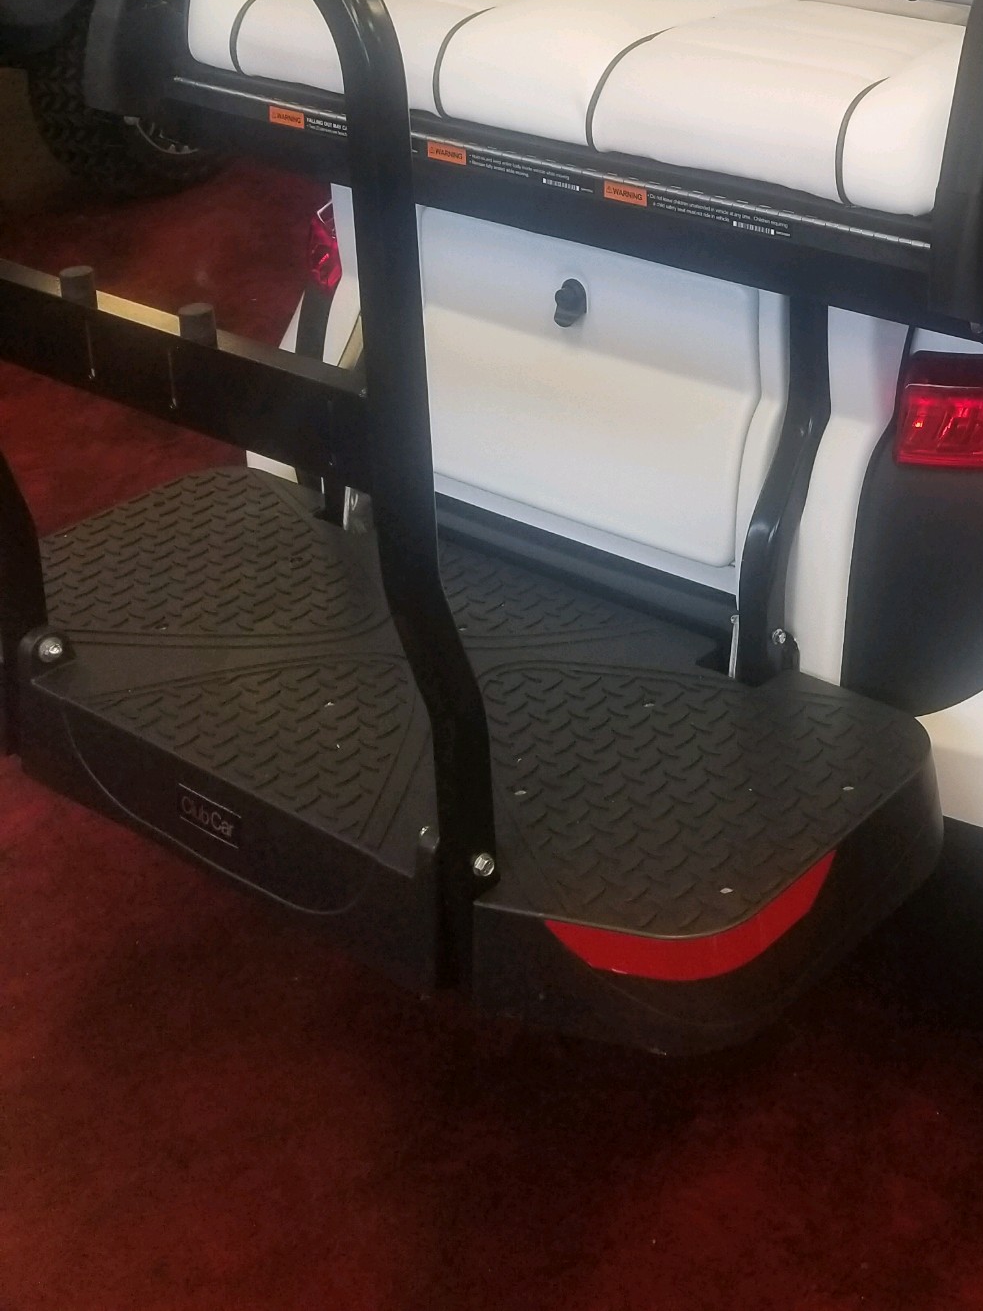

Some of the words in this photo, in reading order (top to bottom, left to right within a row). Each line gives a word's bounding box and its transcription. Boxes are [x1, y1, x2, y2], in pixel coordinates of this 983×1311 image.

[277, 113, 302, 124] WARNING
[435, 148, 463, 160] WARNING
[612, 187, 643, 201] WARNING
[210, 811, 235, 838] Car
